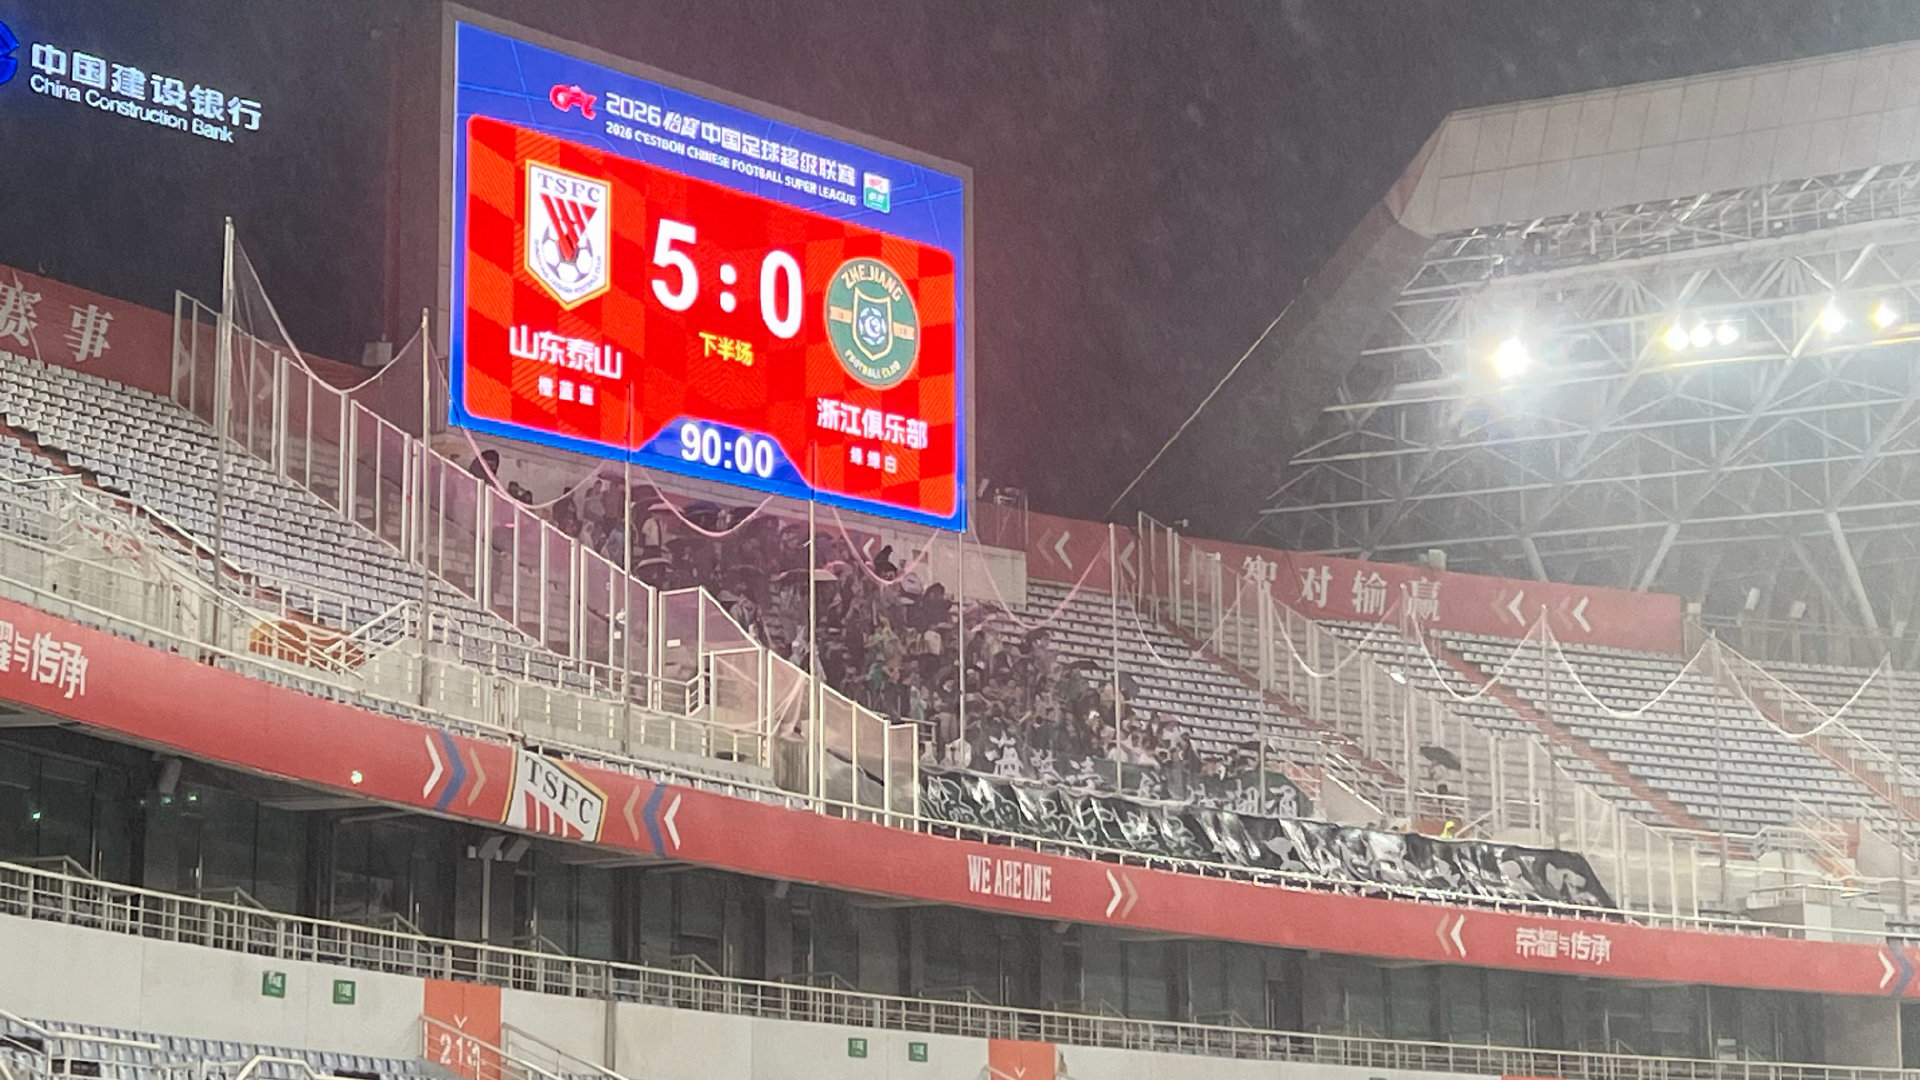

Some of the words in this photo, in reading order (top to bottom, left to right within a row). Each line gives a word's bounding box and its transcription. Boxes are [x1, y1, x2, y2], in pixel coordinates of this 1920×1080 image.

[30, 74, 81, 103] China
[85, 89, 188, 131] Construction
[191, 118, 235, 143] Bank
[31, 43, 262, 131] 中国建设银行
[537, 172, 600, 203] TSFC
[605, 121, 633, 141] 2026
[687, 145, 731, 169] CHINESE
[732, 158, 784, 185] FOOTBALL
[784, 174, 818, 195] SUPER
[818, 185, 857, 206] LEAGUE
[652, 218, 699, 312] 5
[760, 250, 803, 340] 0
[840, 264, 904, 302] ZHEJIANG
[0, 277, 114, 362] 赛事
[509, 324, 622, 380] 山东泰山
[698, 331, 754, 367] 下半场
[680, 423, 774, 478] 90:00
[816, 397, 928, 450] 浙江俱乐部
[524, 756, 594, 824] TSFC
[967, 853, 992, 895] WE
[993, 858, 1022, 899] ARE
[1023, 862, 1052, 903] ONE
[1516, 925, 1612, 966] 荣耀与传承
